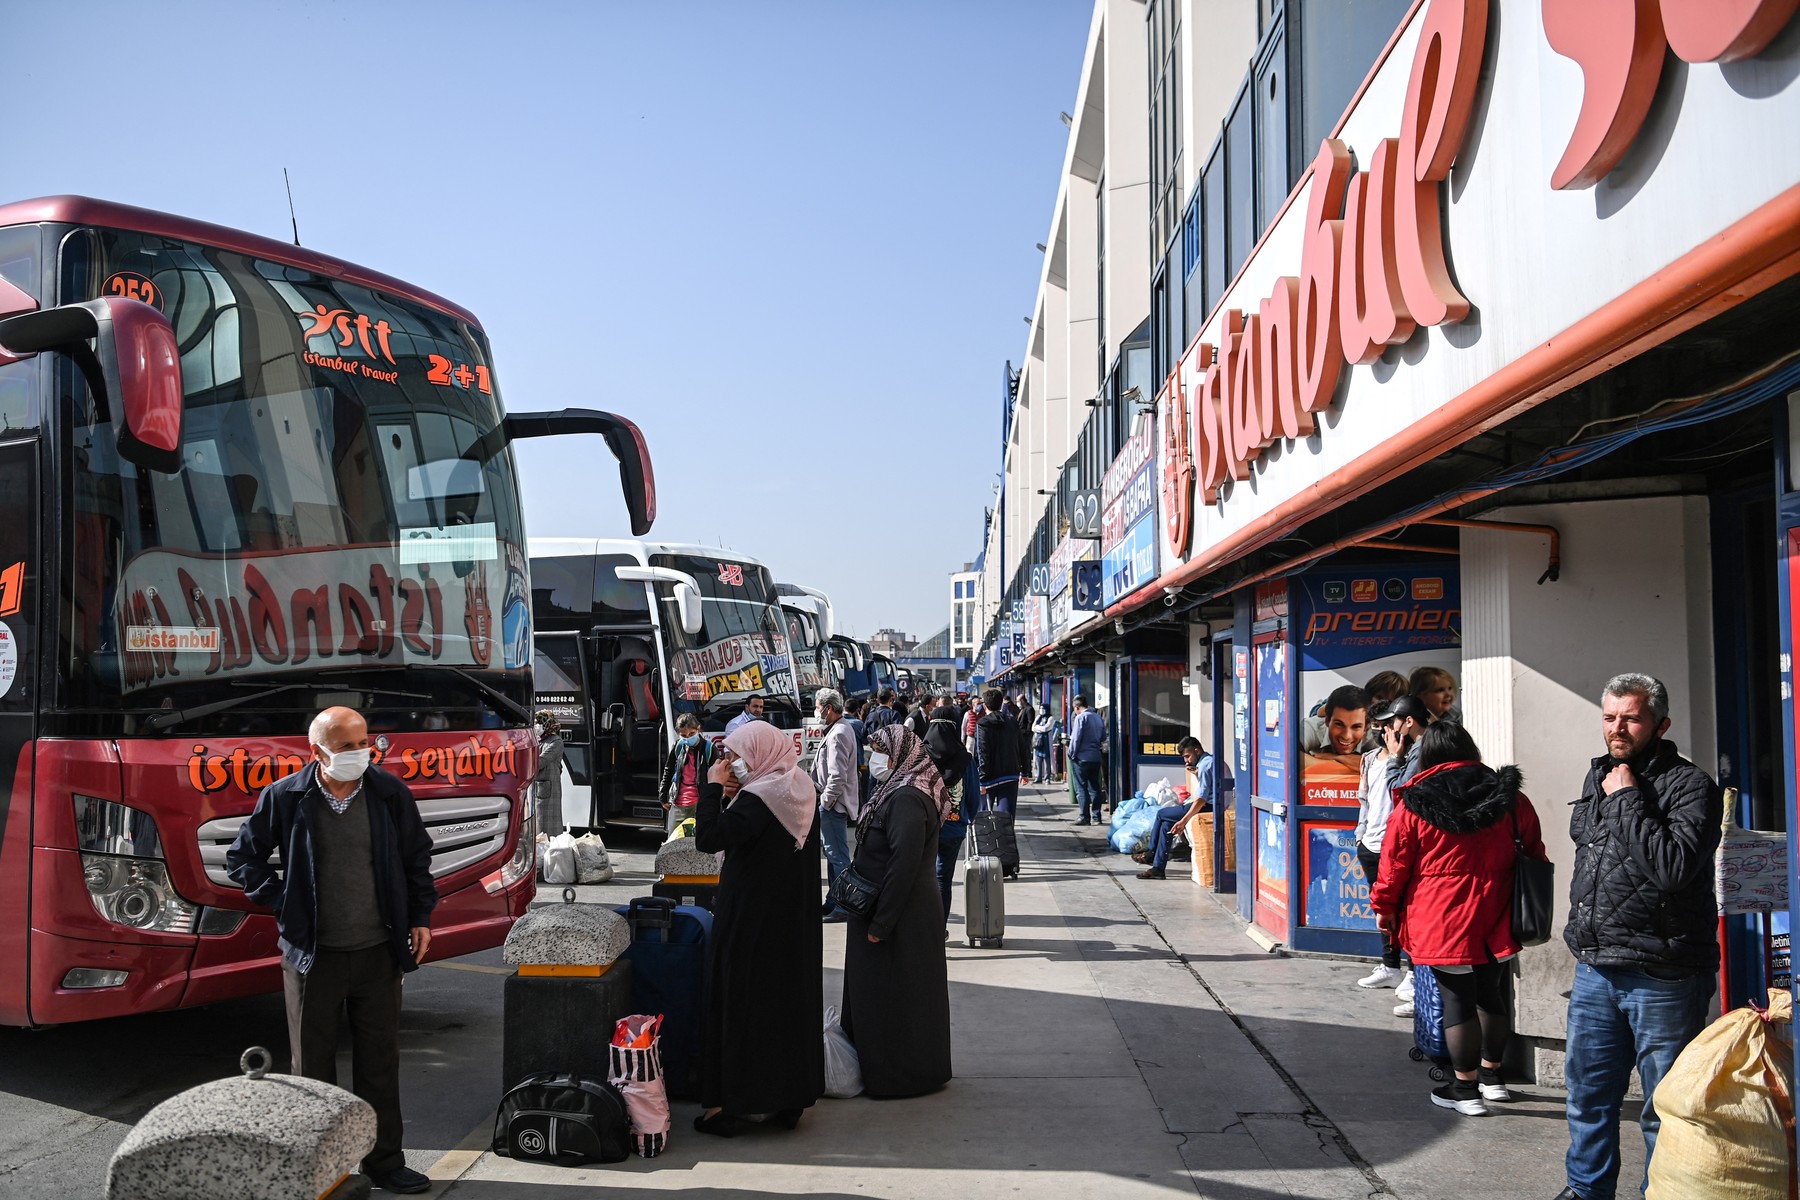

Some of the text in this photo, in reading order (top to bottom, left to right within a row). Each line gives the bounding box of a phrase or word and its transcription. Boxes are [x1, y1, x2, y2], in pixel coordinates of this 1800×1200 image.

[303, 351, 398, 384] istanbul travel
[427, 354, 491, 394] 2+1
[1073, 494, 1098, 534] 62
[1032, 566, 1049, 593] 60
[1012, 601, 1025, 621] 58
[1001, 622, 1010, 637] 56
[1304, 604, 1461, 641] premier
[145, 631, 216, 648] istanbul
[1015, 635, 1027, 655] 59
[1316, 638, 1330, 646] TV
[1341, 636, 1395, 646] INTERNET
[1407, 635, 1456, 645] ANDRO
[1002, 648, 1010, 665] 57
[402, 736, 518, 786] seyahat
[1307, 786, 1338, 800] ÇAĞRI
[437, 821, 490, 835] TRAVEGO
[1340, 903, 1377, 919] KAZ
[524, 1136, 540, 1149] 60
